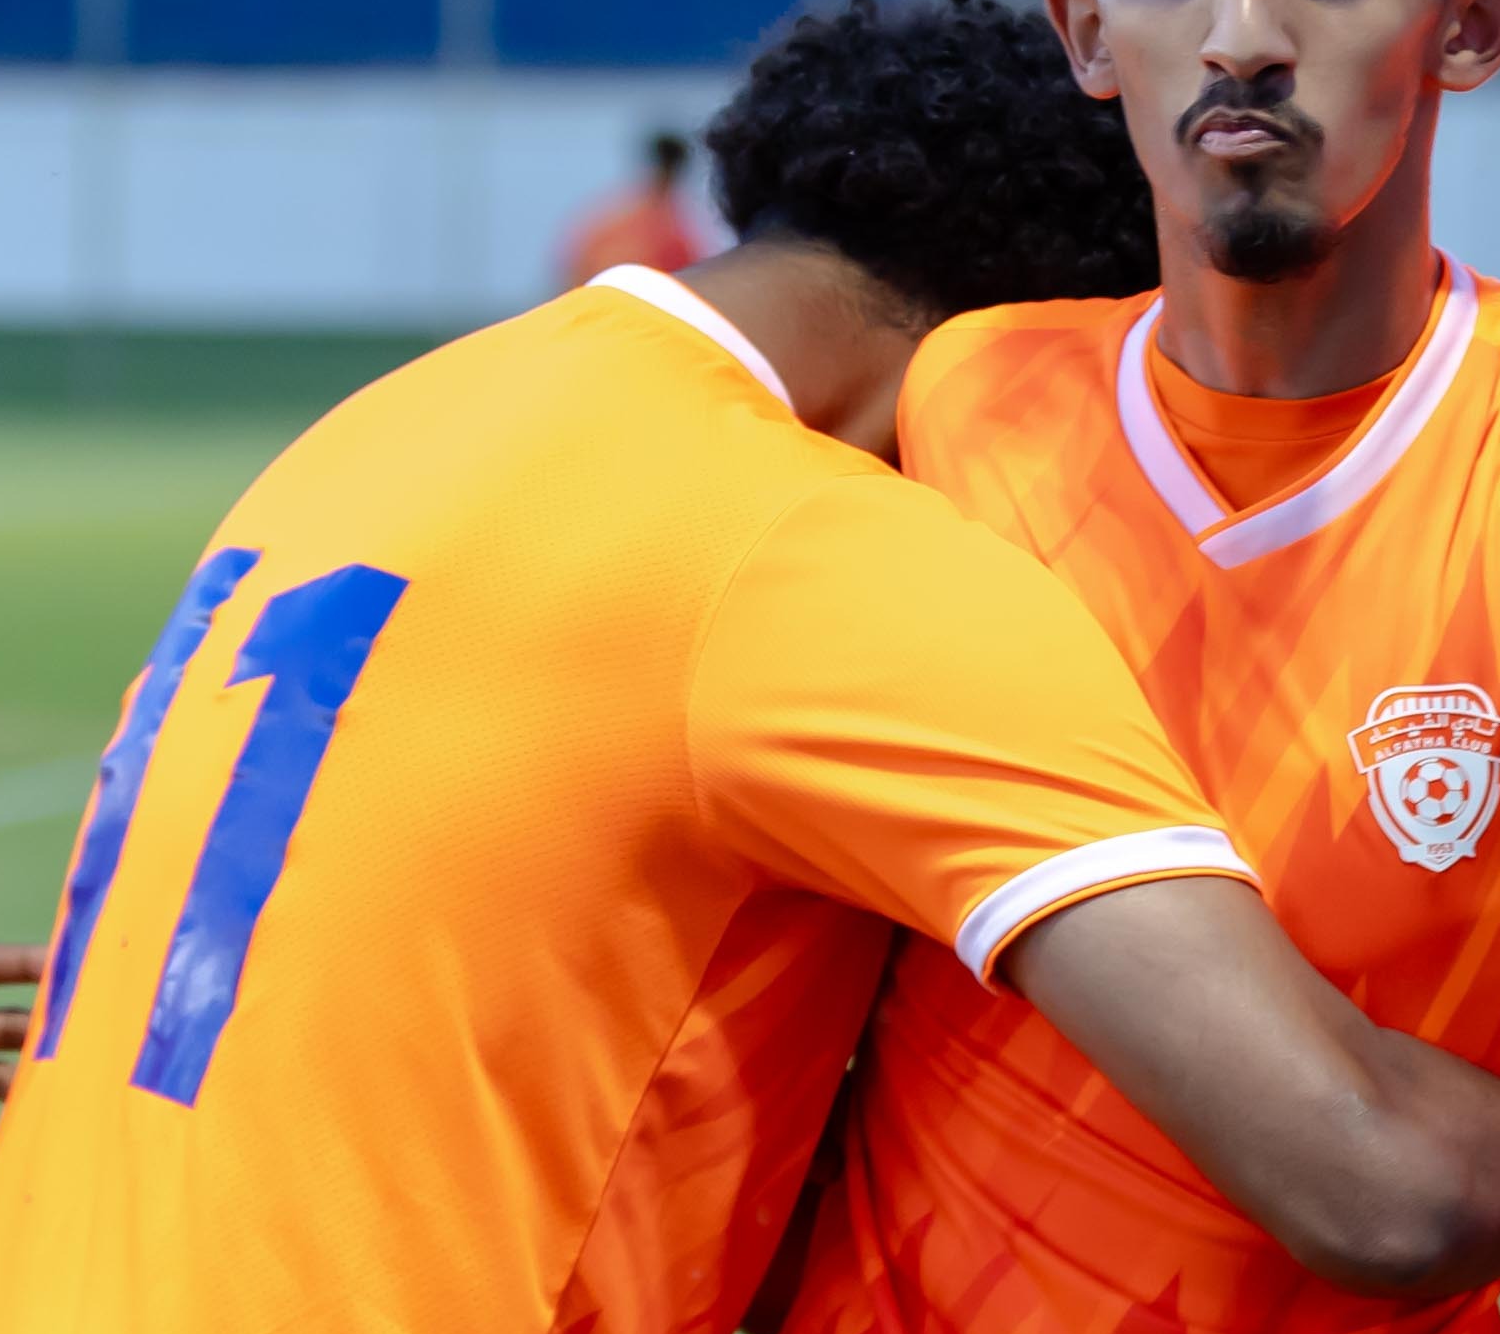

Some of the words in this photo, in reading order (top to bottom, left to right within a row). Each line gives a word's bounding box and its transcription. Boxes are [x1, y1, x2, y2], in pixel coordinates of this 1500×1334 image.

[32, 546, 412, 1109] 11
[1375, 736, 1446, 760] ALFAYHA
[1450, 737, 1492, 754] CLUB
